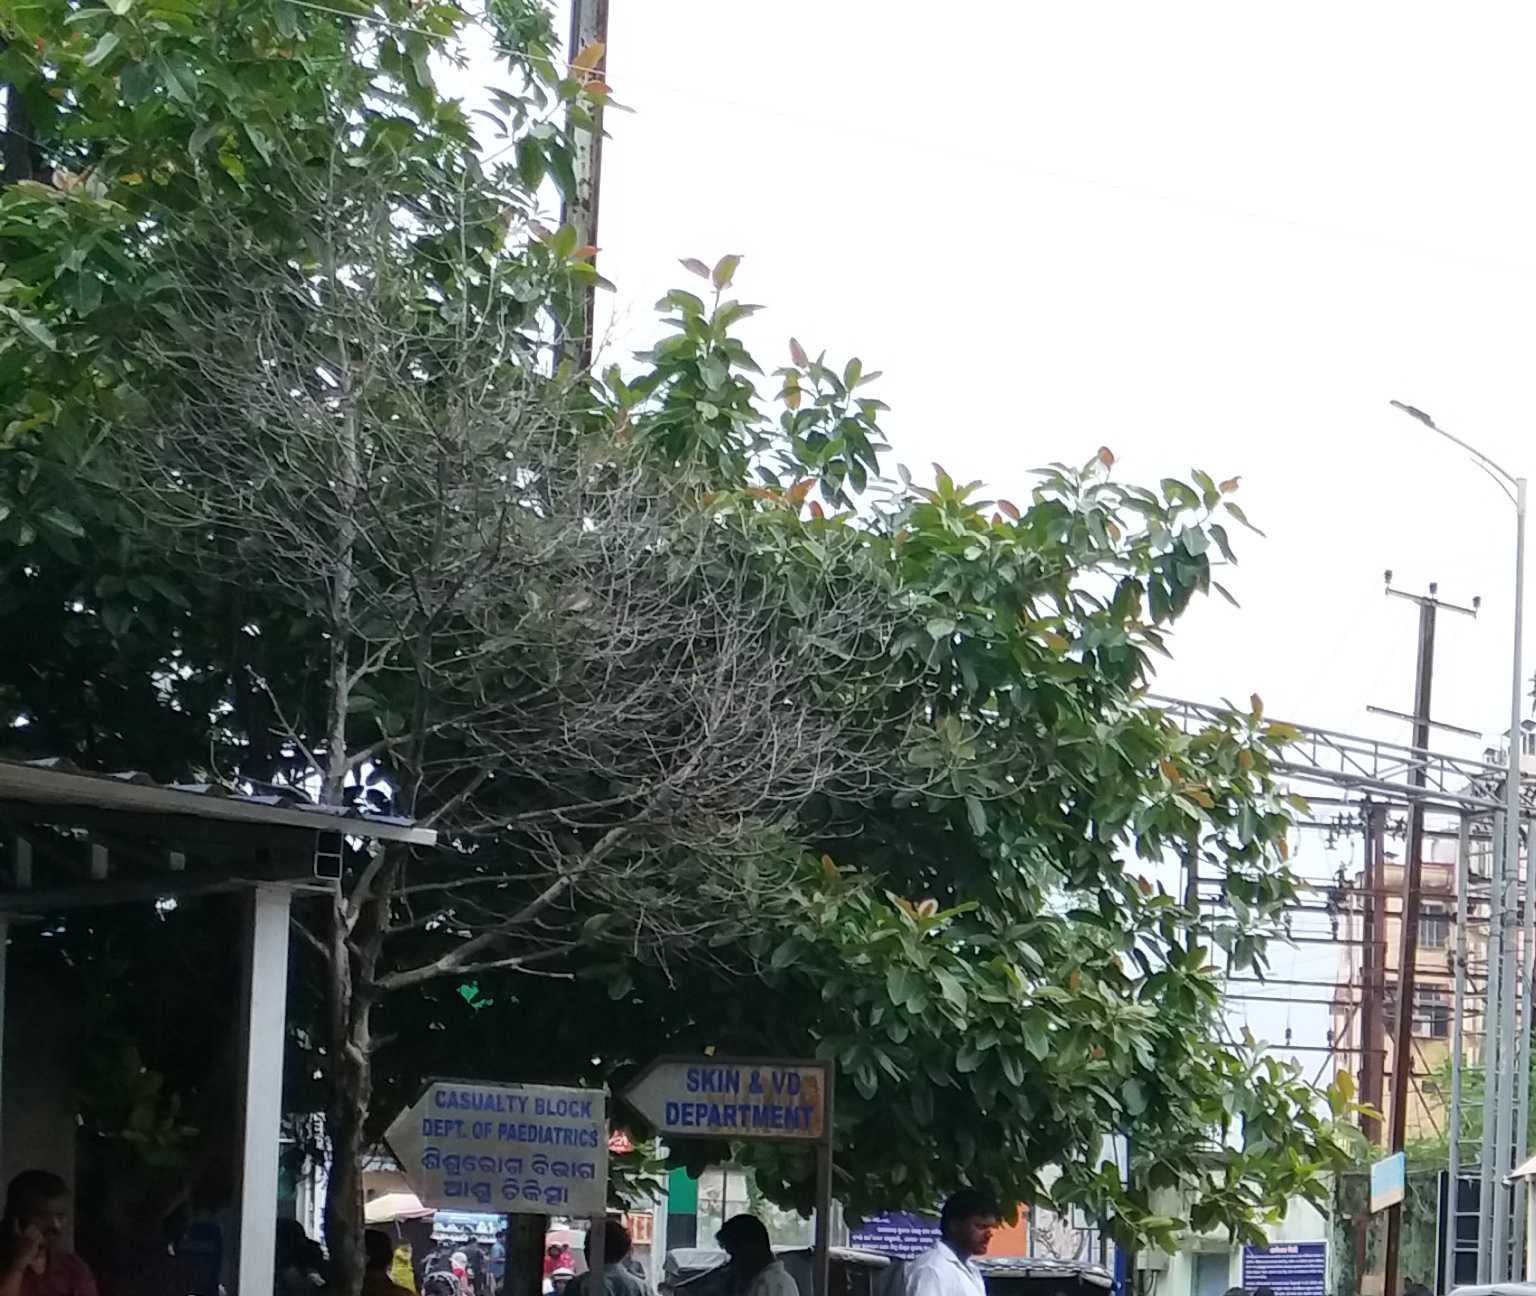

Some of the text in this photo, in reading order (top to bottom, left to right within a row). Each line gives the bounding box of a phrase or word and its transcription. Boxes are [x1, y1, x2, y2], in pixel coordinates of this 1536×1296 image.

[686, 1067, 801, 1096] SKIN & VD
[435, 1090, 592, 1118] CASUALTY BLOCK
[665, 1102, 814, 1129] DEPARTMENT
[422, 1118, 598, 1148] DEPT. OF PAEDIATRICS
